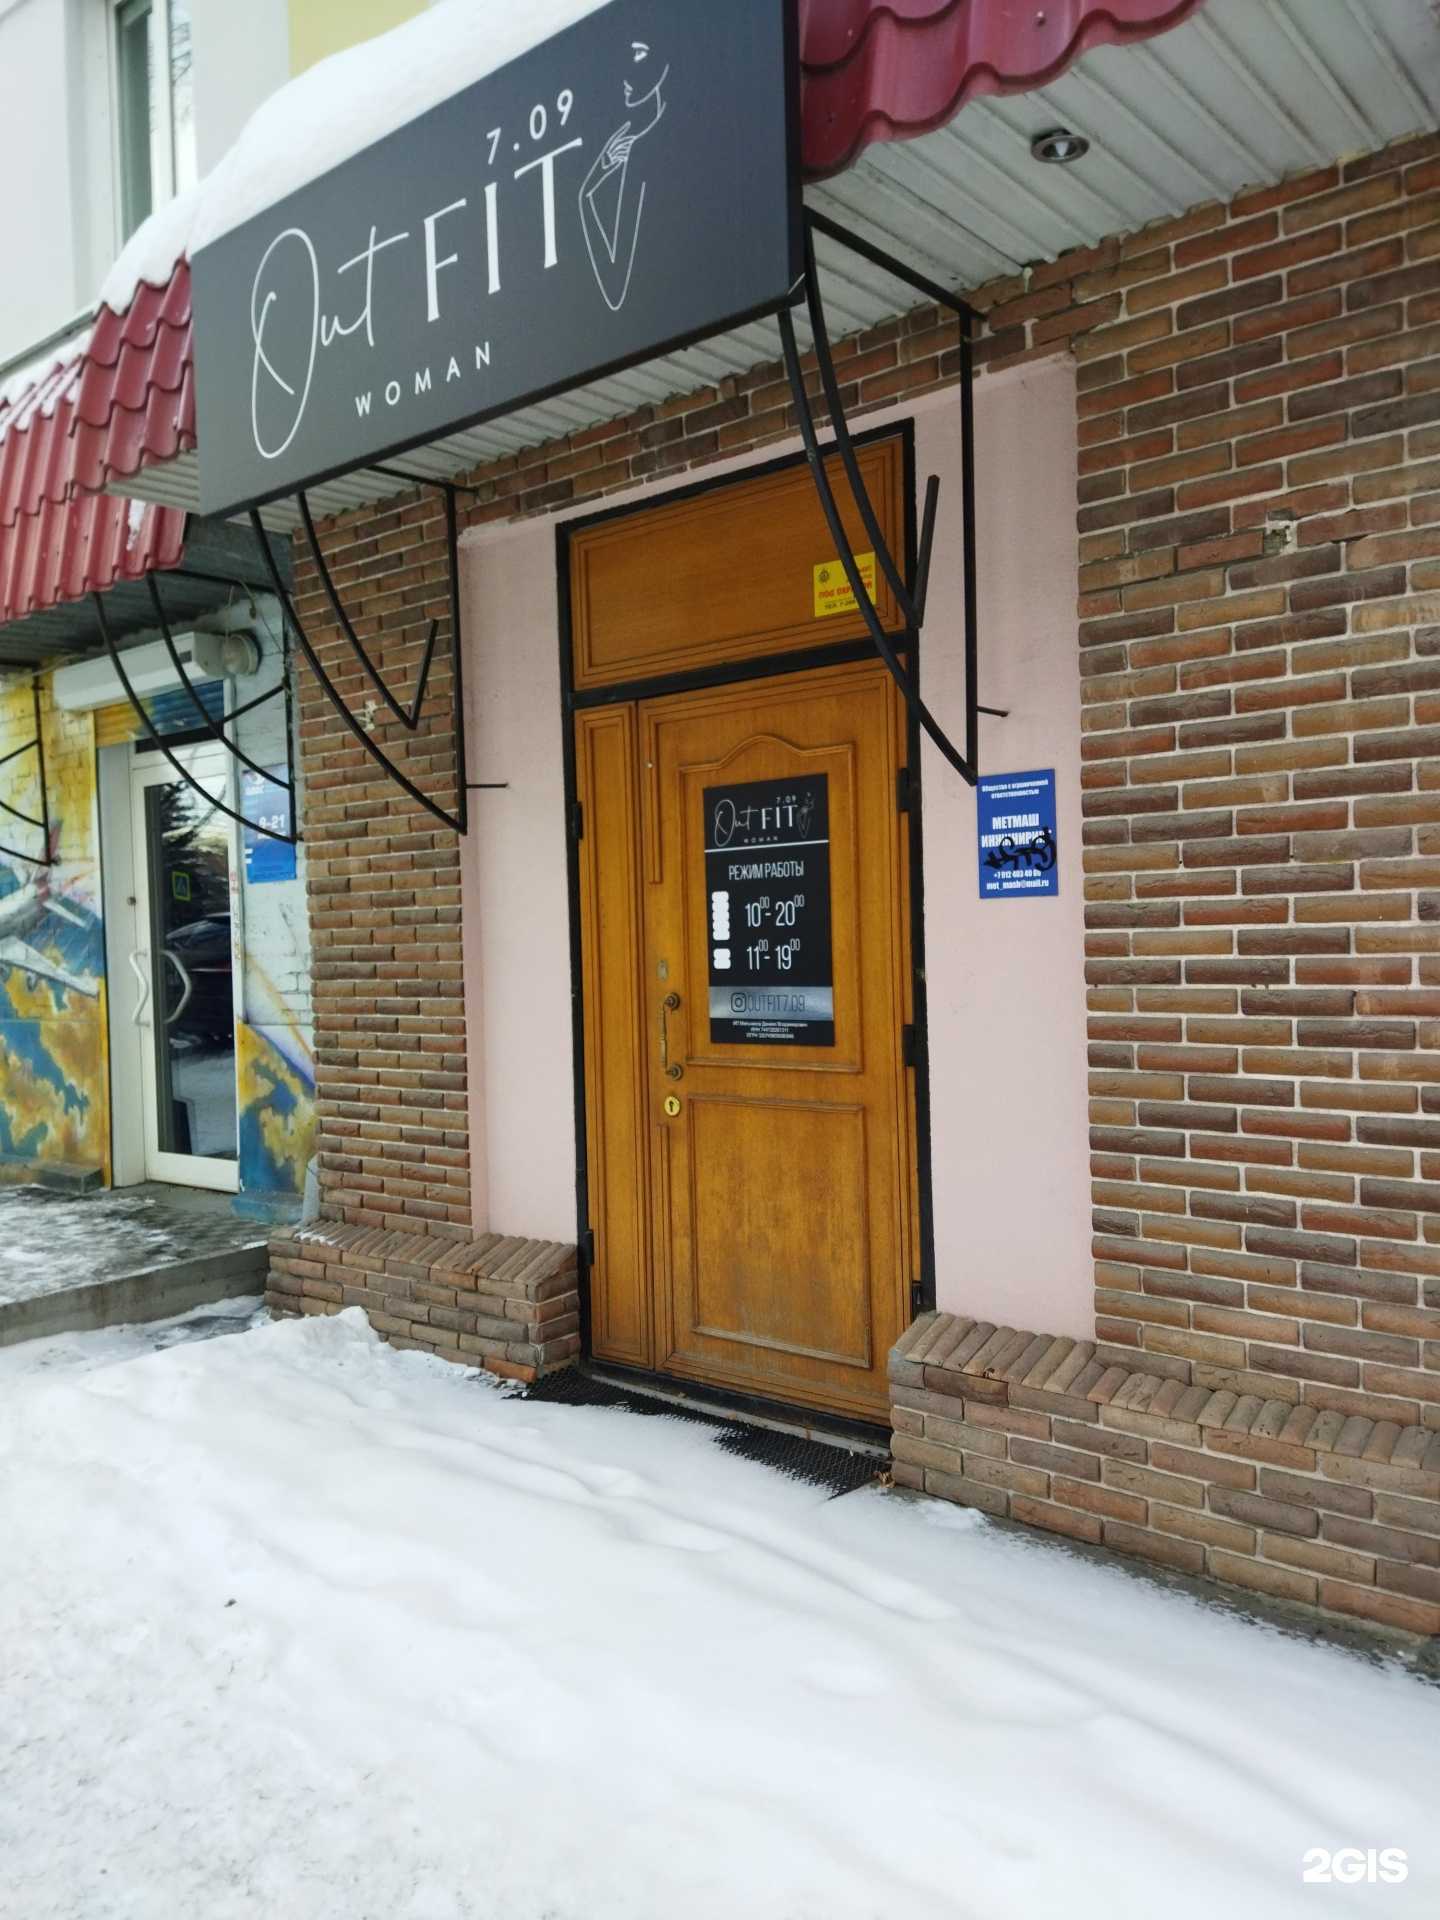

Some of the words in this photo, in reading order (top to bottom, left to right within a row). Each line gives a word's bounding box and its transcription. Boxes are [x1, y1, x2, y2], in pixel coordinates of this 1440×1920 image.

[486, 88, 575, 165] 7.09
[354, 340, 493, 417] WOMAN
[991, 813, 1040, 830] МЕТМАШ
[728, 863, 763, 881] РЕЖИМ
[764, 860, 804, 879] РАБОТЫ
